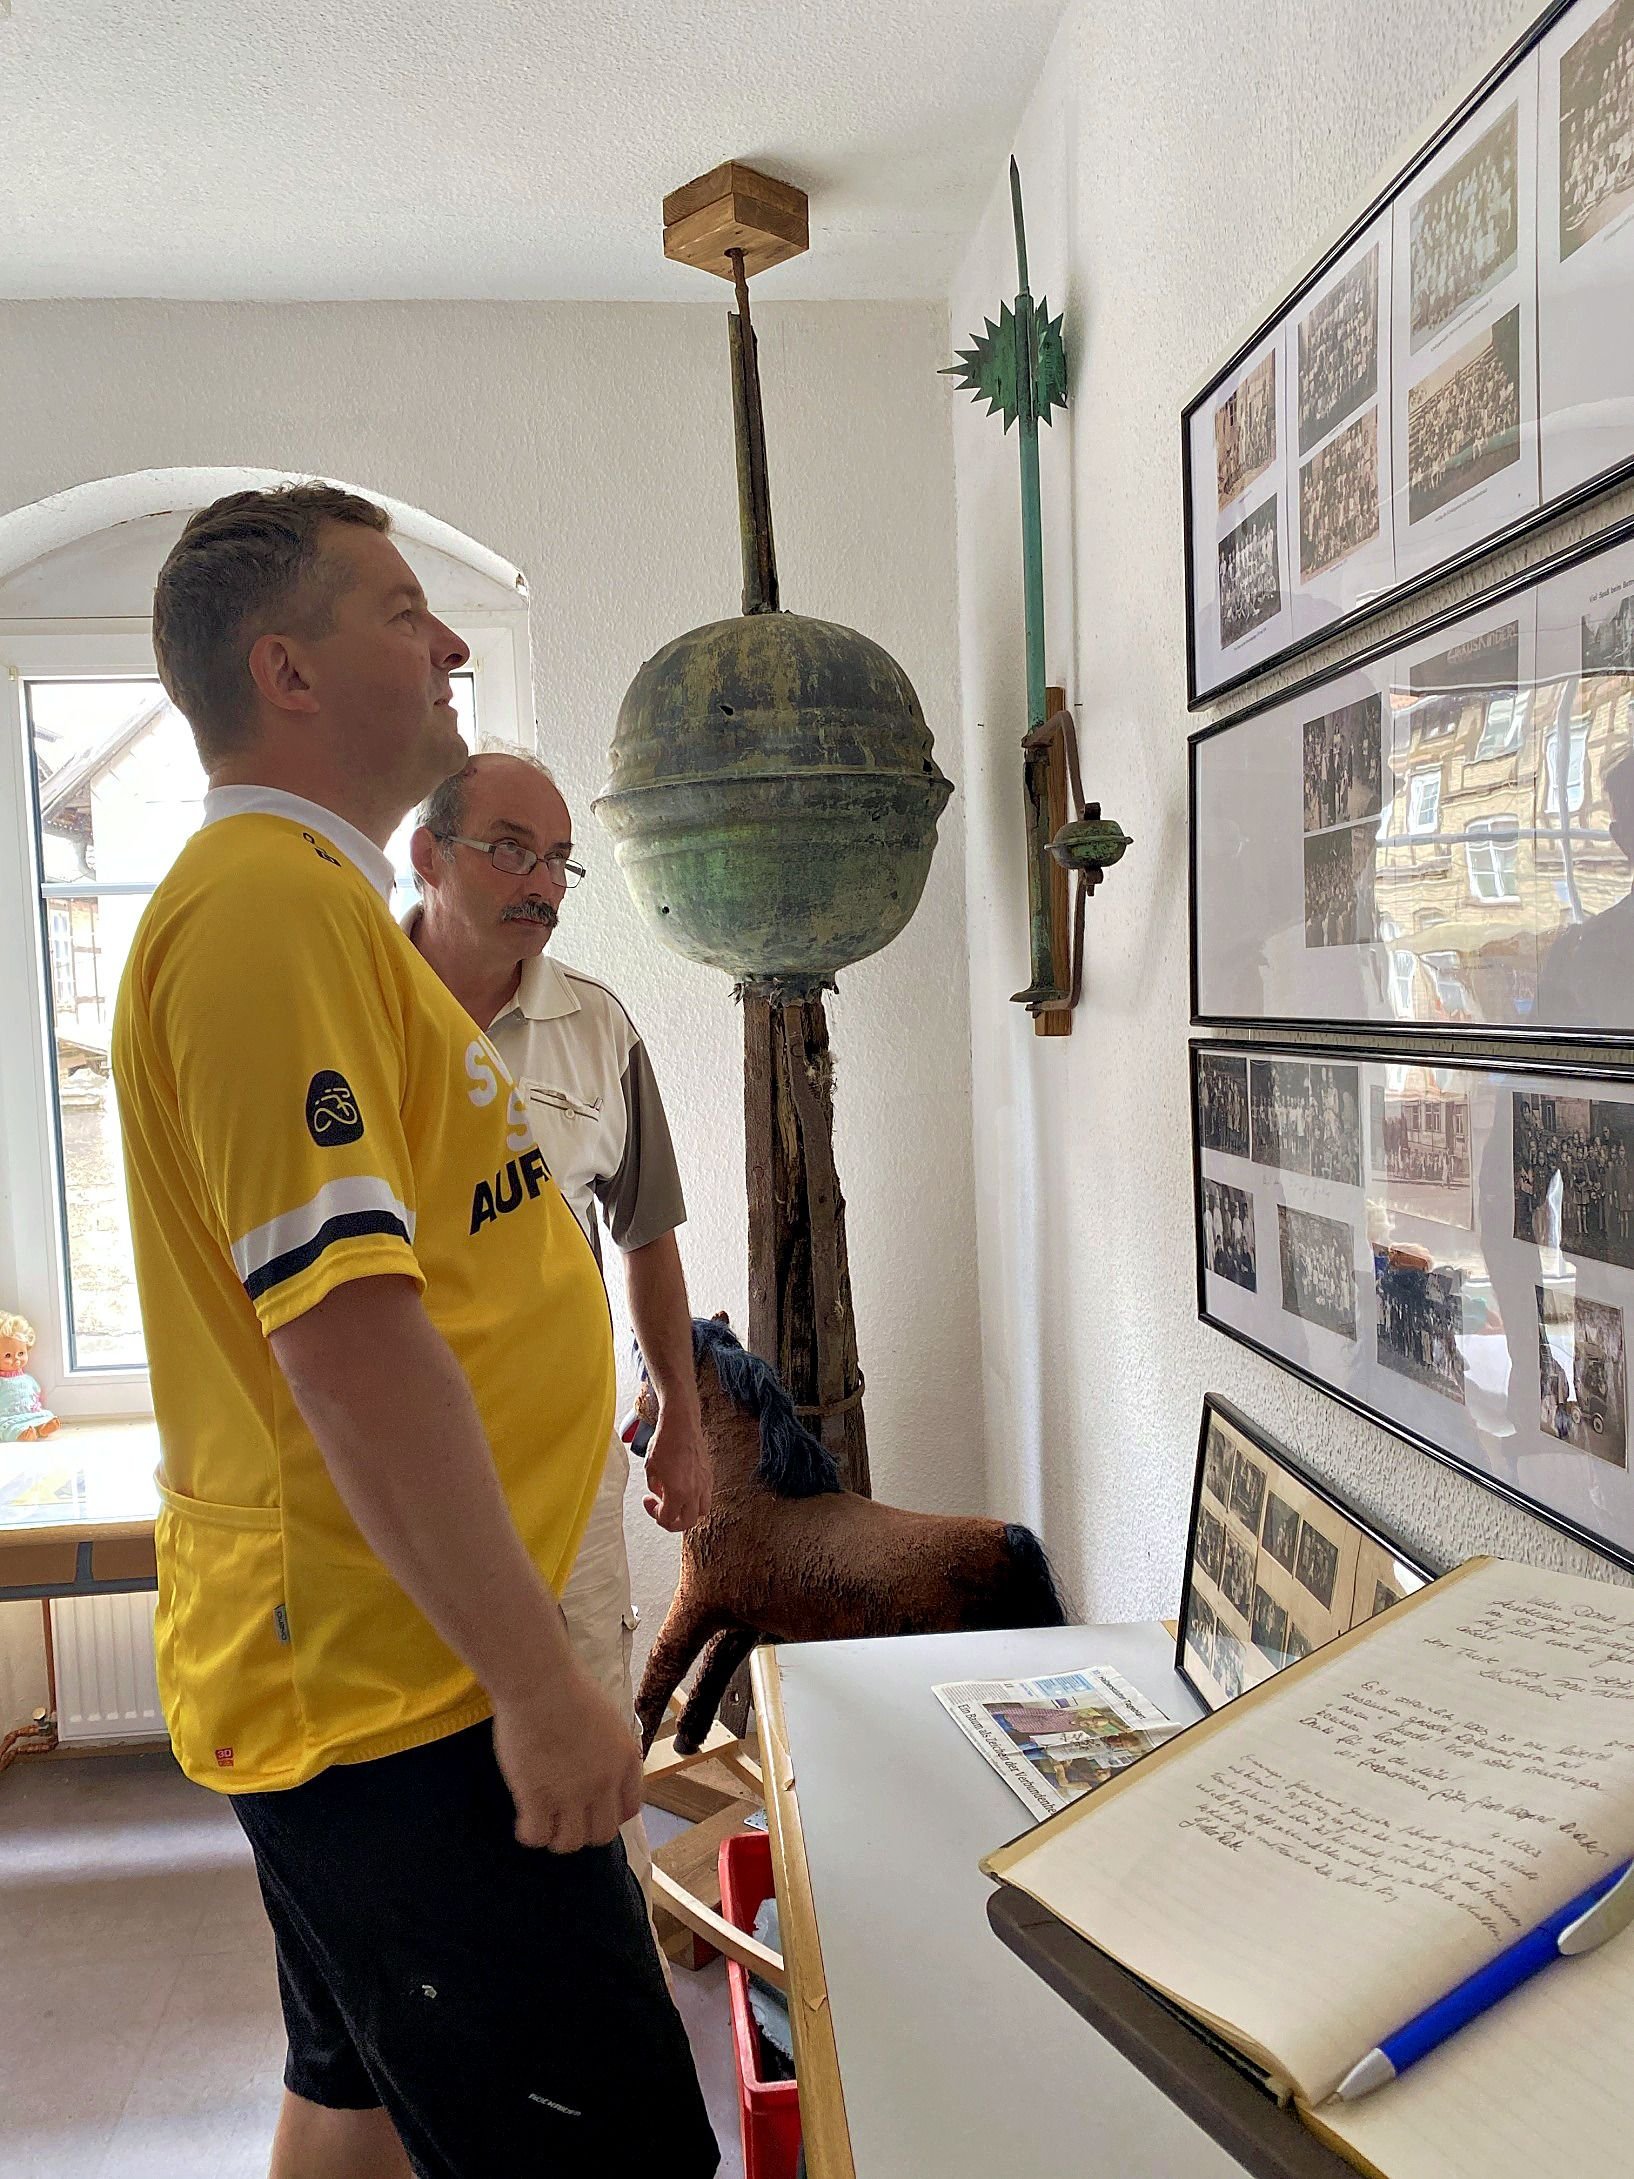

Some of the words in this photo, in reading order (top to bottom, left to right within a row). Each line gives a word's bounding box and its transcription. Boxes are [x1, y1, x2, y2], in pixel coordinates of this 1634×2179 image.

[469, 1146, 552, 1236] AUF
[958, 1703, 971, 1715] Ein
[966, 1711, 984, 1731] Baum
[979, 1728, 991, 1738] als
[1004, 1759, 1019, 1775] der
[1014, 1771, 1057, 1815] Verbundenhe
